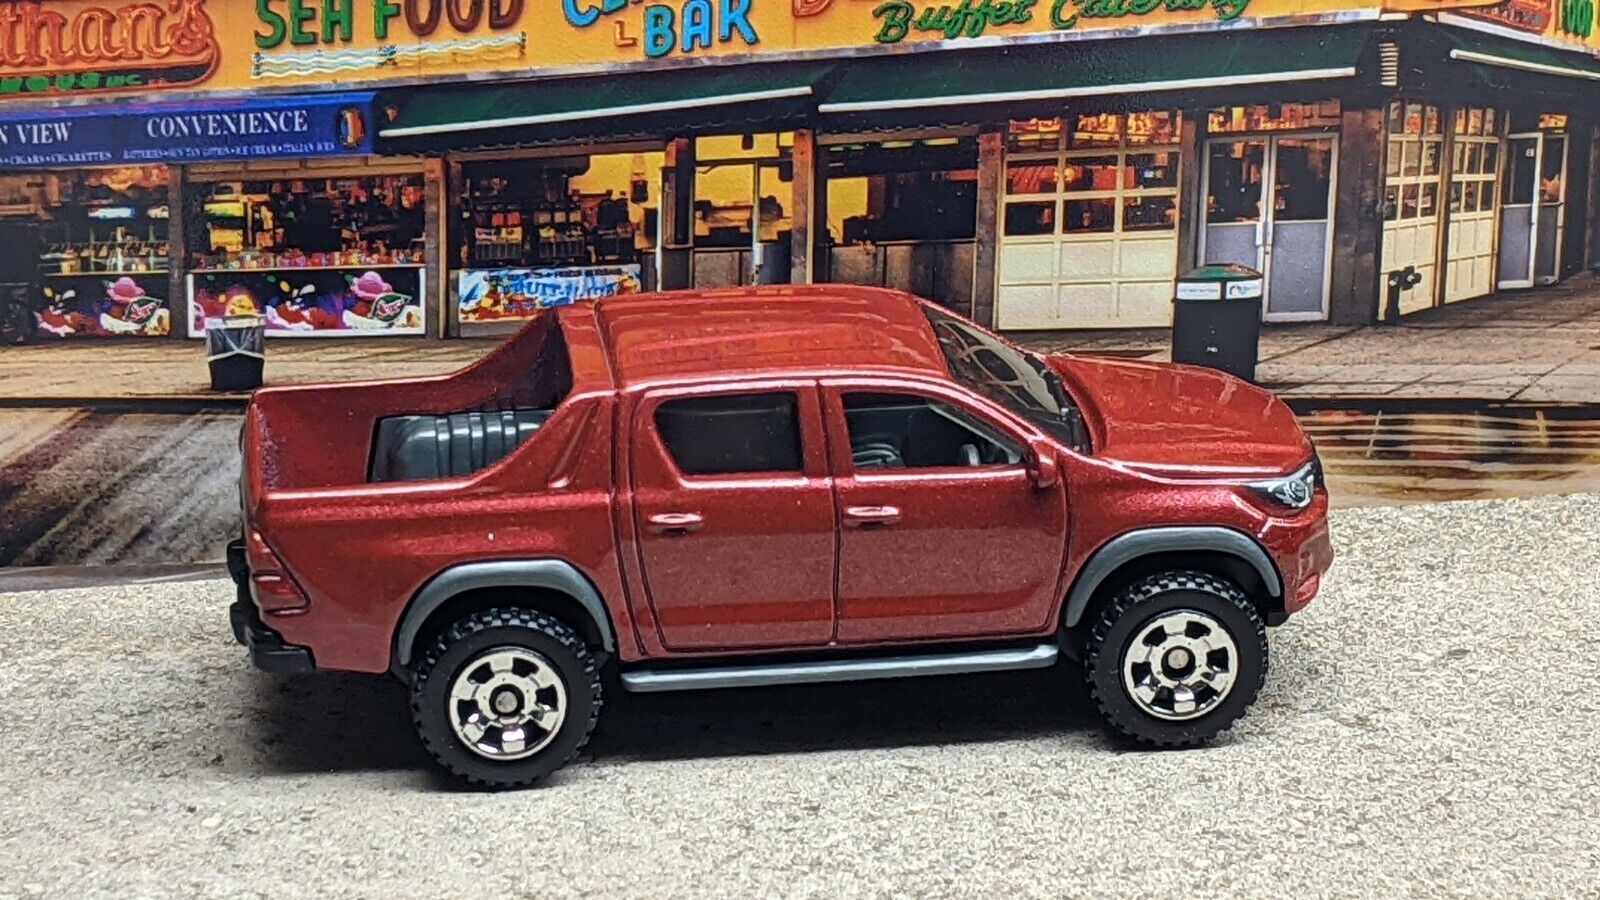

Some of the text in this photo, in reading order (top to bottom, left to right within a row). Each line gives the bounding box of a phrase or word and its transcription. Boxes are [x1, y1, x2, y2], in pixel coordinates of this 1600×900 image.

[373, 0, 525, 39] FOOD
[643, 0, 760, 59] BAR
[872, 0, 1036, 44] Buffet
[16, 122, 72, 144] VIEW
[146, 110, 308, 138] CONVENIENCE
